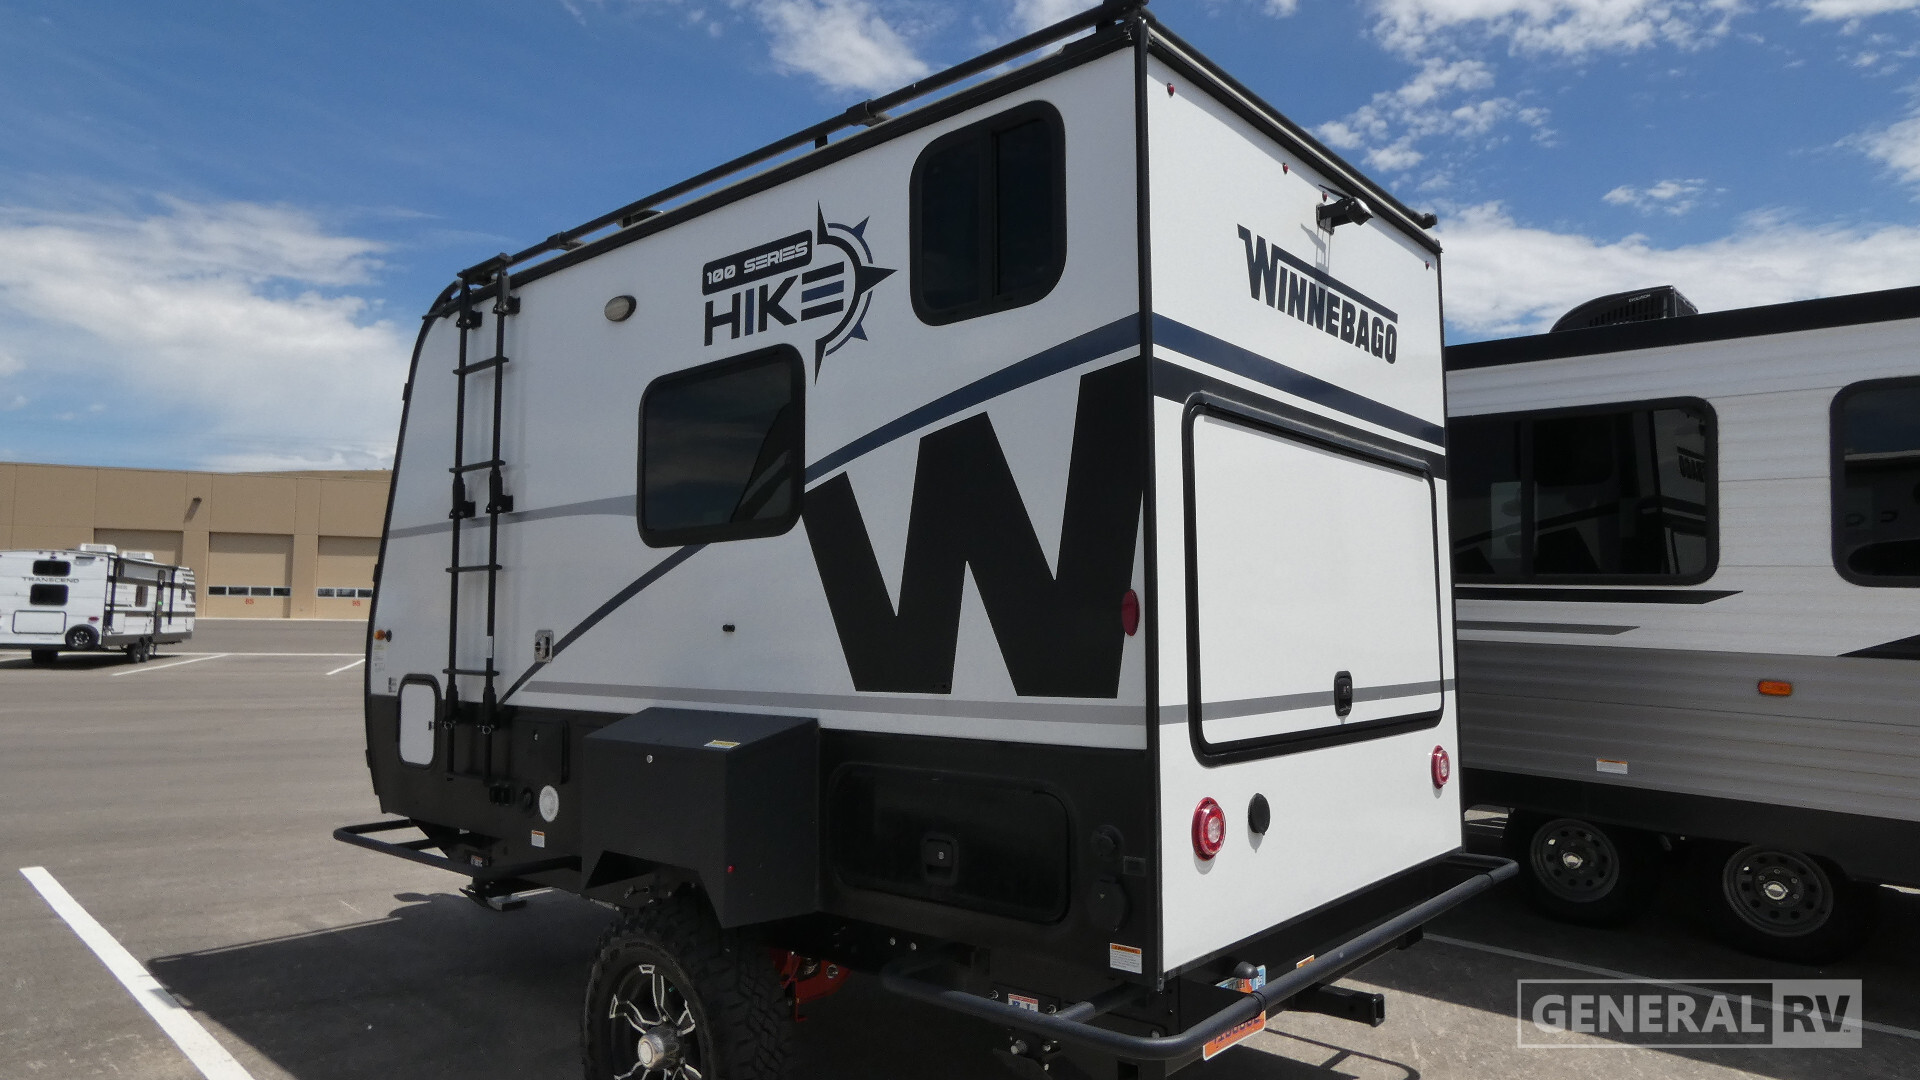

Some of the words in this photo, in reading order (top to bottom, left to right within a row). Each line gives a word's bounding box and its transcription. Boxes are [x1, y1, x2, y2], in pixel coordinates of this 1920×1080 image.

[704, 260, 845, 346] HIKE
[706, 264, 736, 284] 100
[743, 241, 808, 274] SERIES
[1237, 223, 1398, 364] WINNEBAGO
[800, 355, 1143, 699] W
[22, 576, 80, 584] TRANSCEND
